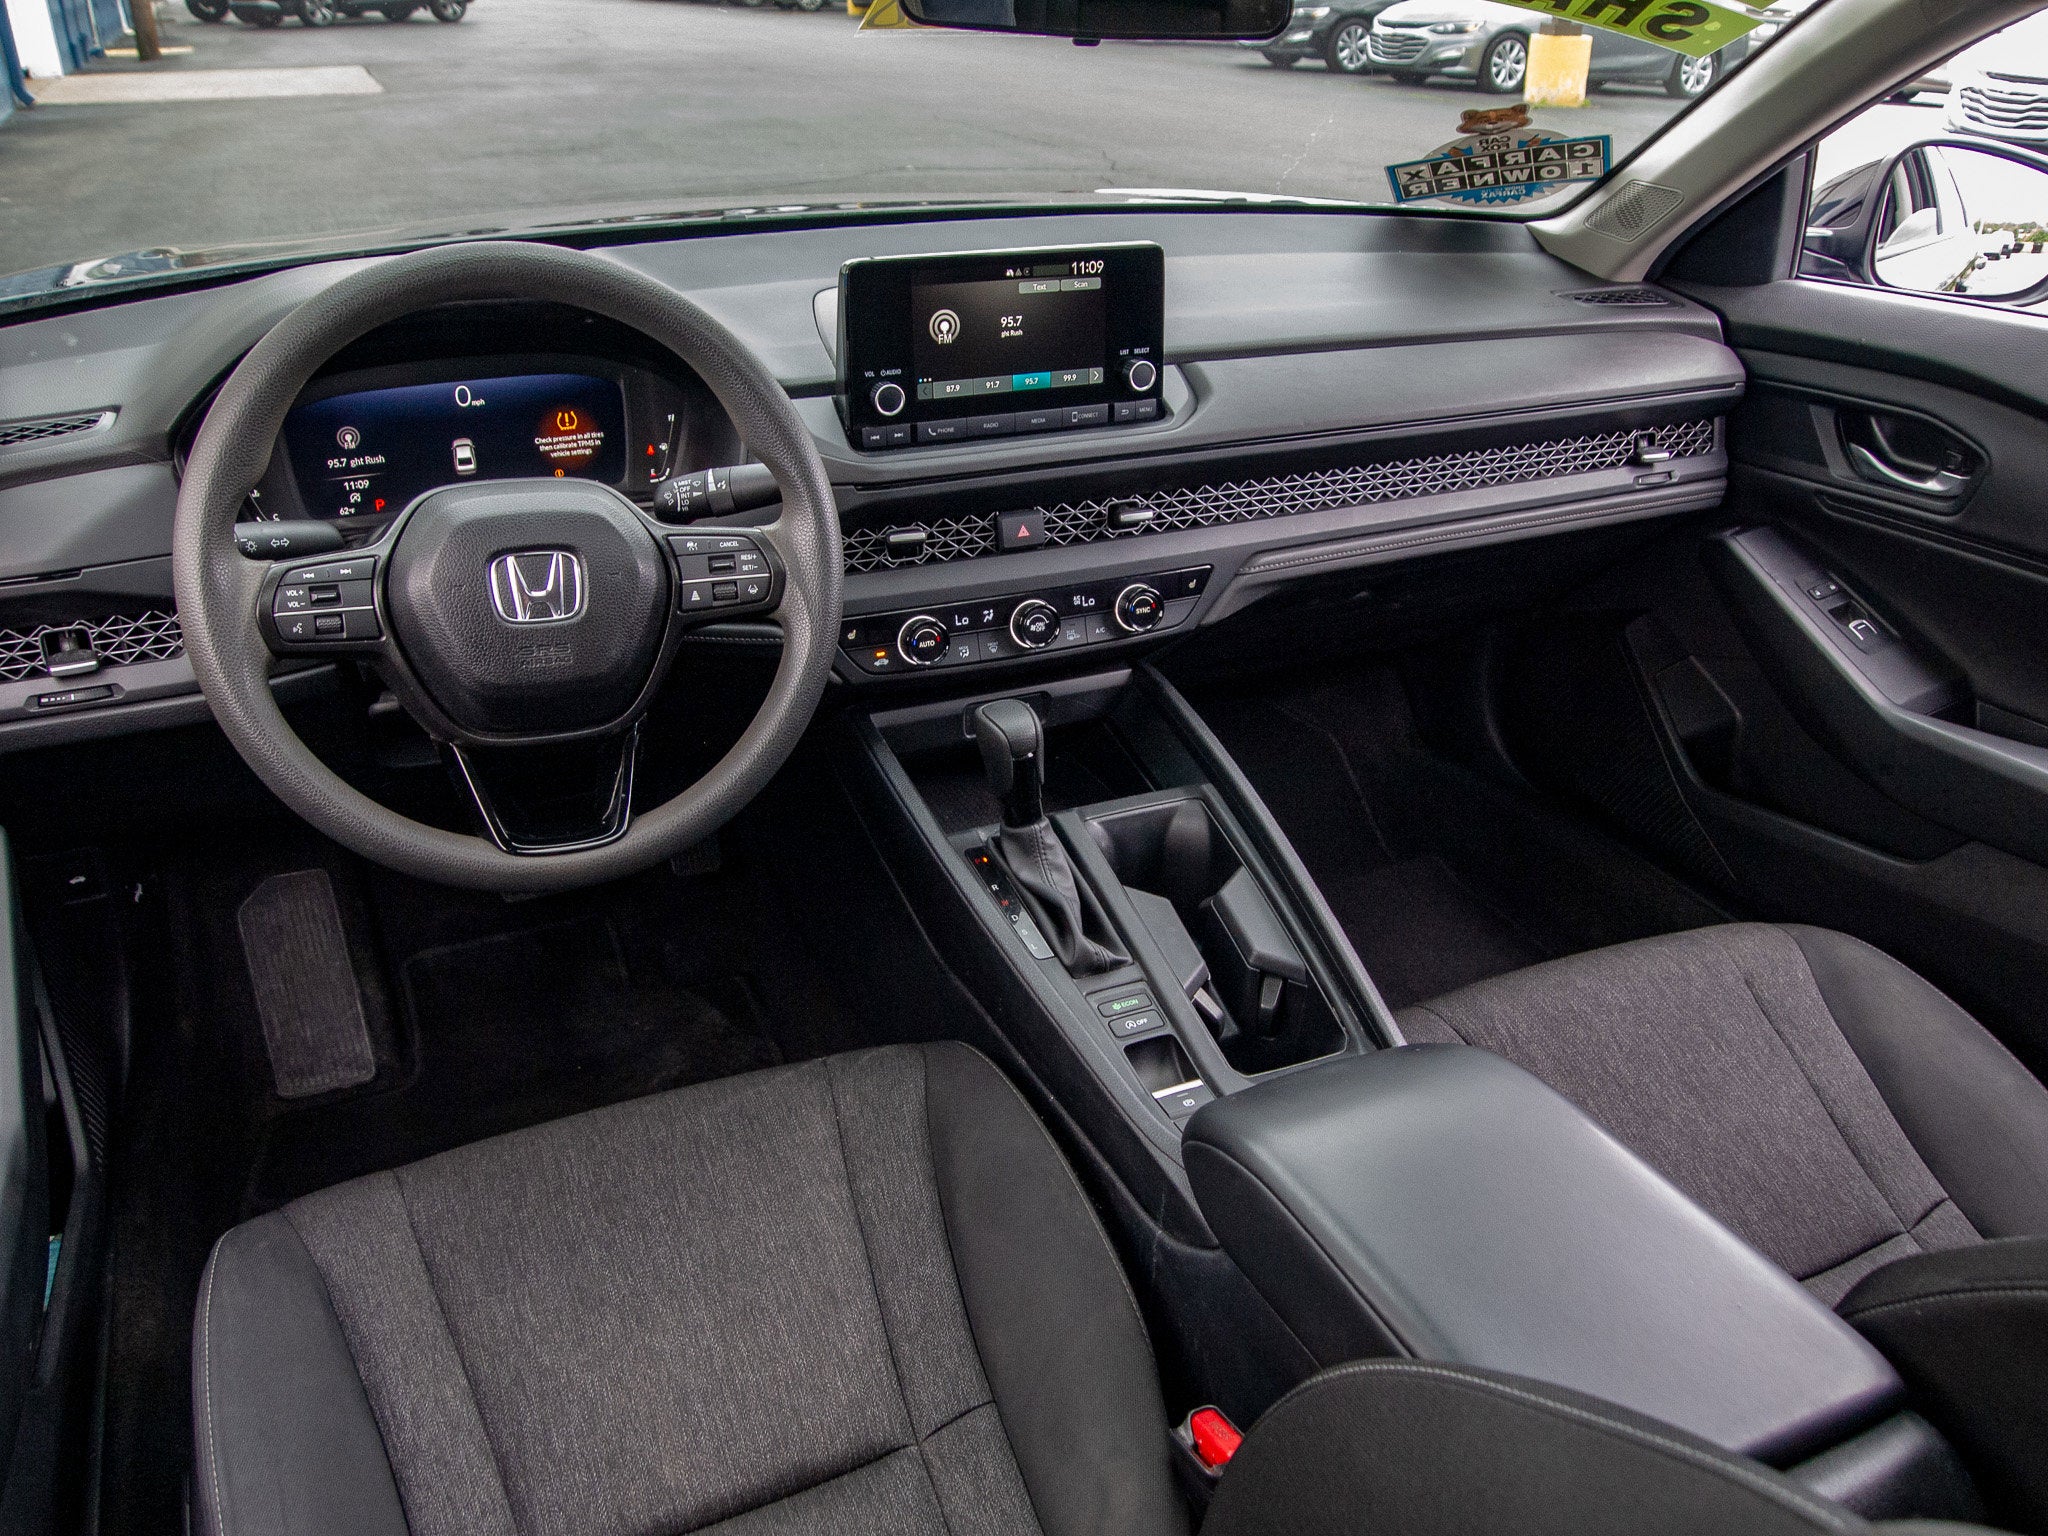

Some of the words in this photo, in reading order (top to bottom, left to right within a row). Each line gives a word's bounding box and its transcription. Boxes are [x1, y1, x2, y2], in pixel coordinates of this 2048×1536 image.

[1071, 261, 1105, 276] 11:09
[1033, 283, 1047, 292] Text
[1073, 280, 1089, 289] Scan
[1000, 315, 1023, 328] 95.7
[937, 333, 953, 345] FM
[885, 368, 902, 376] AUDIO
[1024, 377, 1039, 386] 95.7
[1063, 373, 1077, 382] 99.9
[945, 384, 960, 393] 87.9
[985, 380, 1000, 389] 91.7
[454, 385, 472, 407] 0
[471, 398, 486, 407] mph
[534, 436, 553, 445] Check
[552, 434, 577, 443] pressure
[591, 431, 604, 439] tires
[344, 441, 356, 450] FM
[539, 444, 553, 452] then
[553, 441, 578, 450] calibrate
[577, 439, 594, 447] TPMS
[550, 449, 571, 458] vehicle
[570, 448, 593, 456] settings
[327, 457, 347, 469] 95.7
[350, 457, 364, 468] ght
[364, 454, 386, 465] Rush
[343, 479, 370, 491] 11:09
[375, 498, 386, 512] P
[1082, 595, 1096, 607] Lo
[1135, 606, 1151, 614] SYNC
[954, 614, 969, 626] Lo
[919, 640, 936, 648] AUTO
[1011, 914, 1019, 922] D
[1121, 998, 1139, 1008] ECON
[1136, 1017, 1148, 1026] OFF
